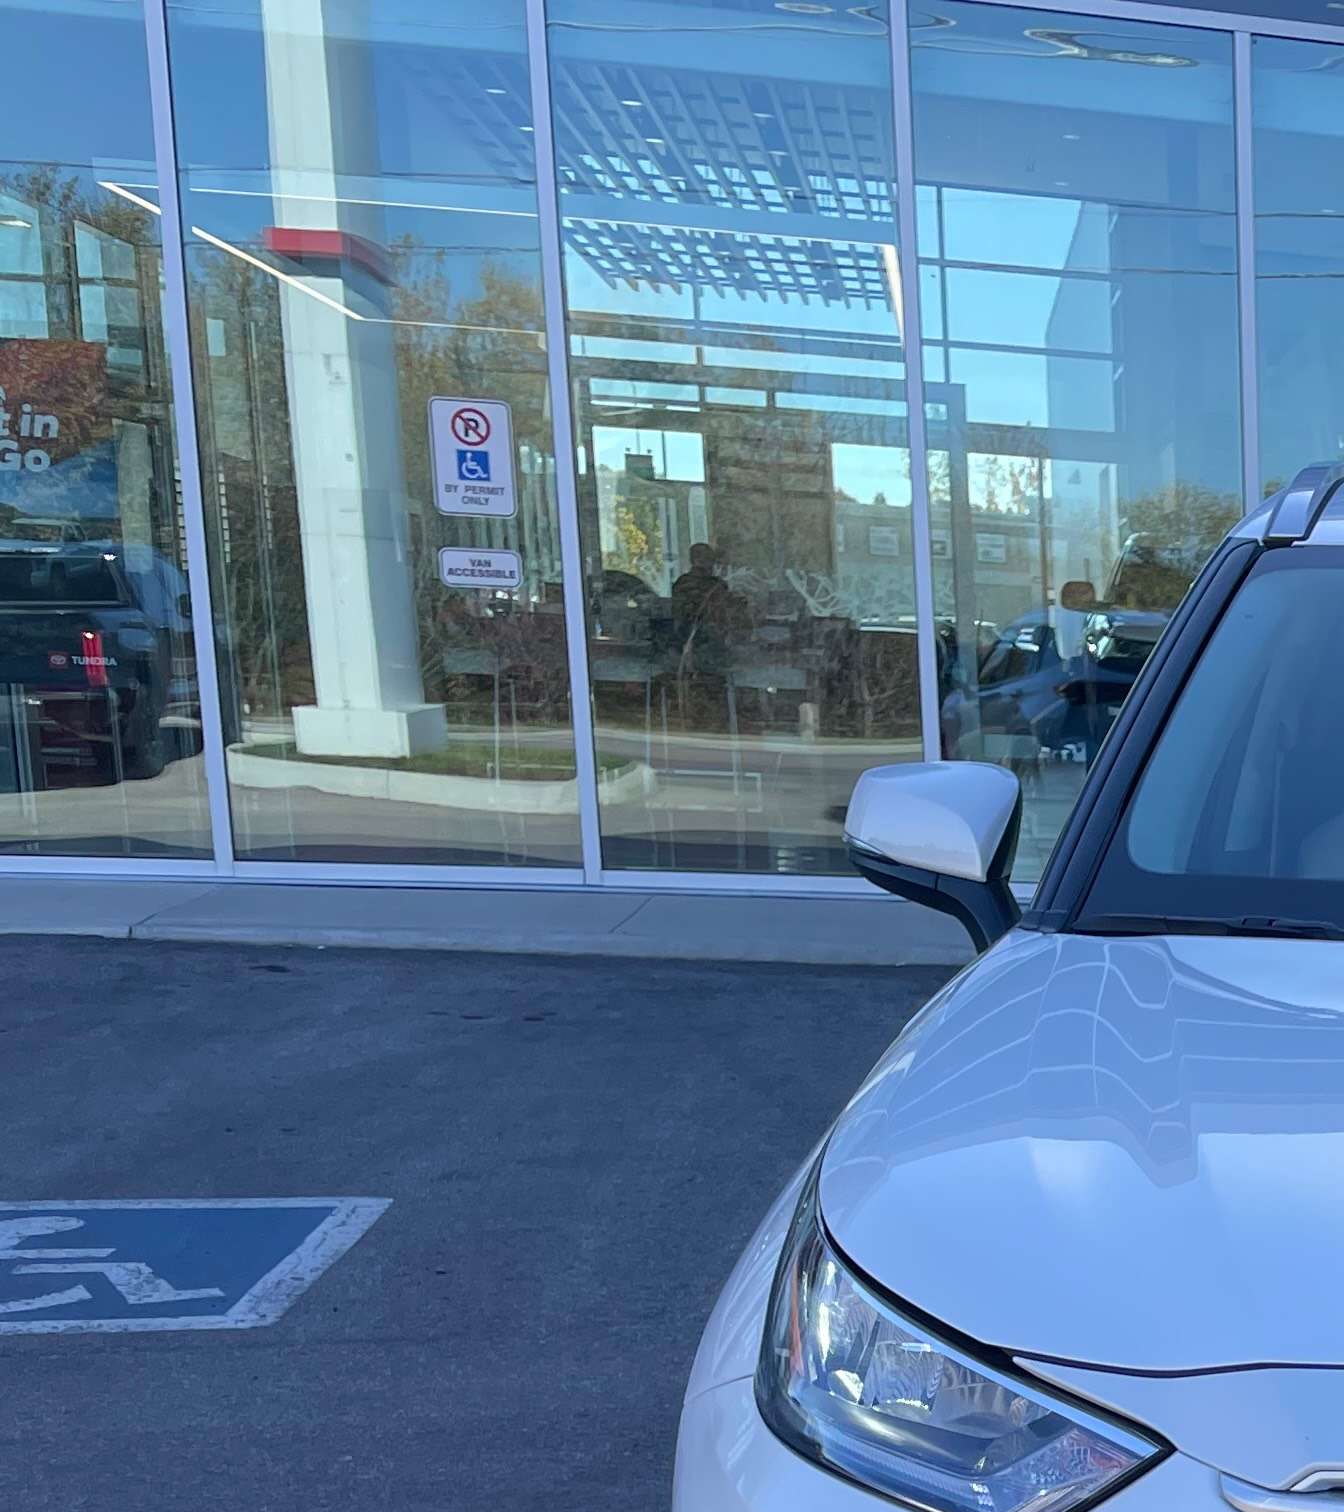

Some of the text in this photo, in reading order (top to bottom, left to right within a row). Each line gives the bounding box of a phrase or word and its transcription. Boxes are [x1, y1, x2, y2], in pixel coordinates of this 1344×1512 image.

[20, 403, 59, 438] in
[444, 483, 505, 496] BY PERMIT
[461, 496, 489, 506] ONLY
[469, 558, 492, 568] VAN
[446, 567, 516, 579] ACCESSIBLE
[71, 655, 118, 667] TUNDRA
